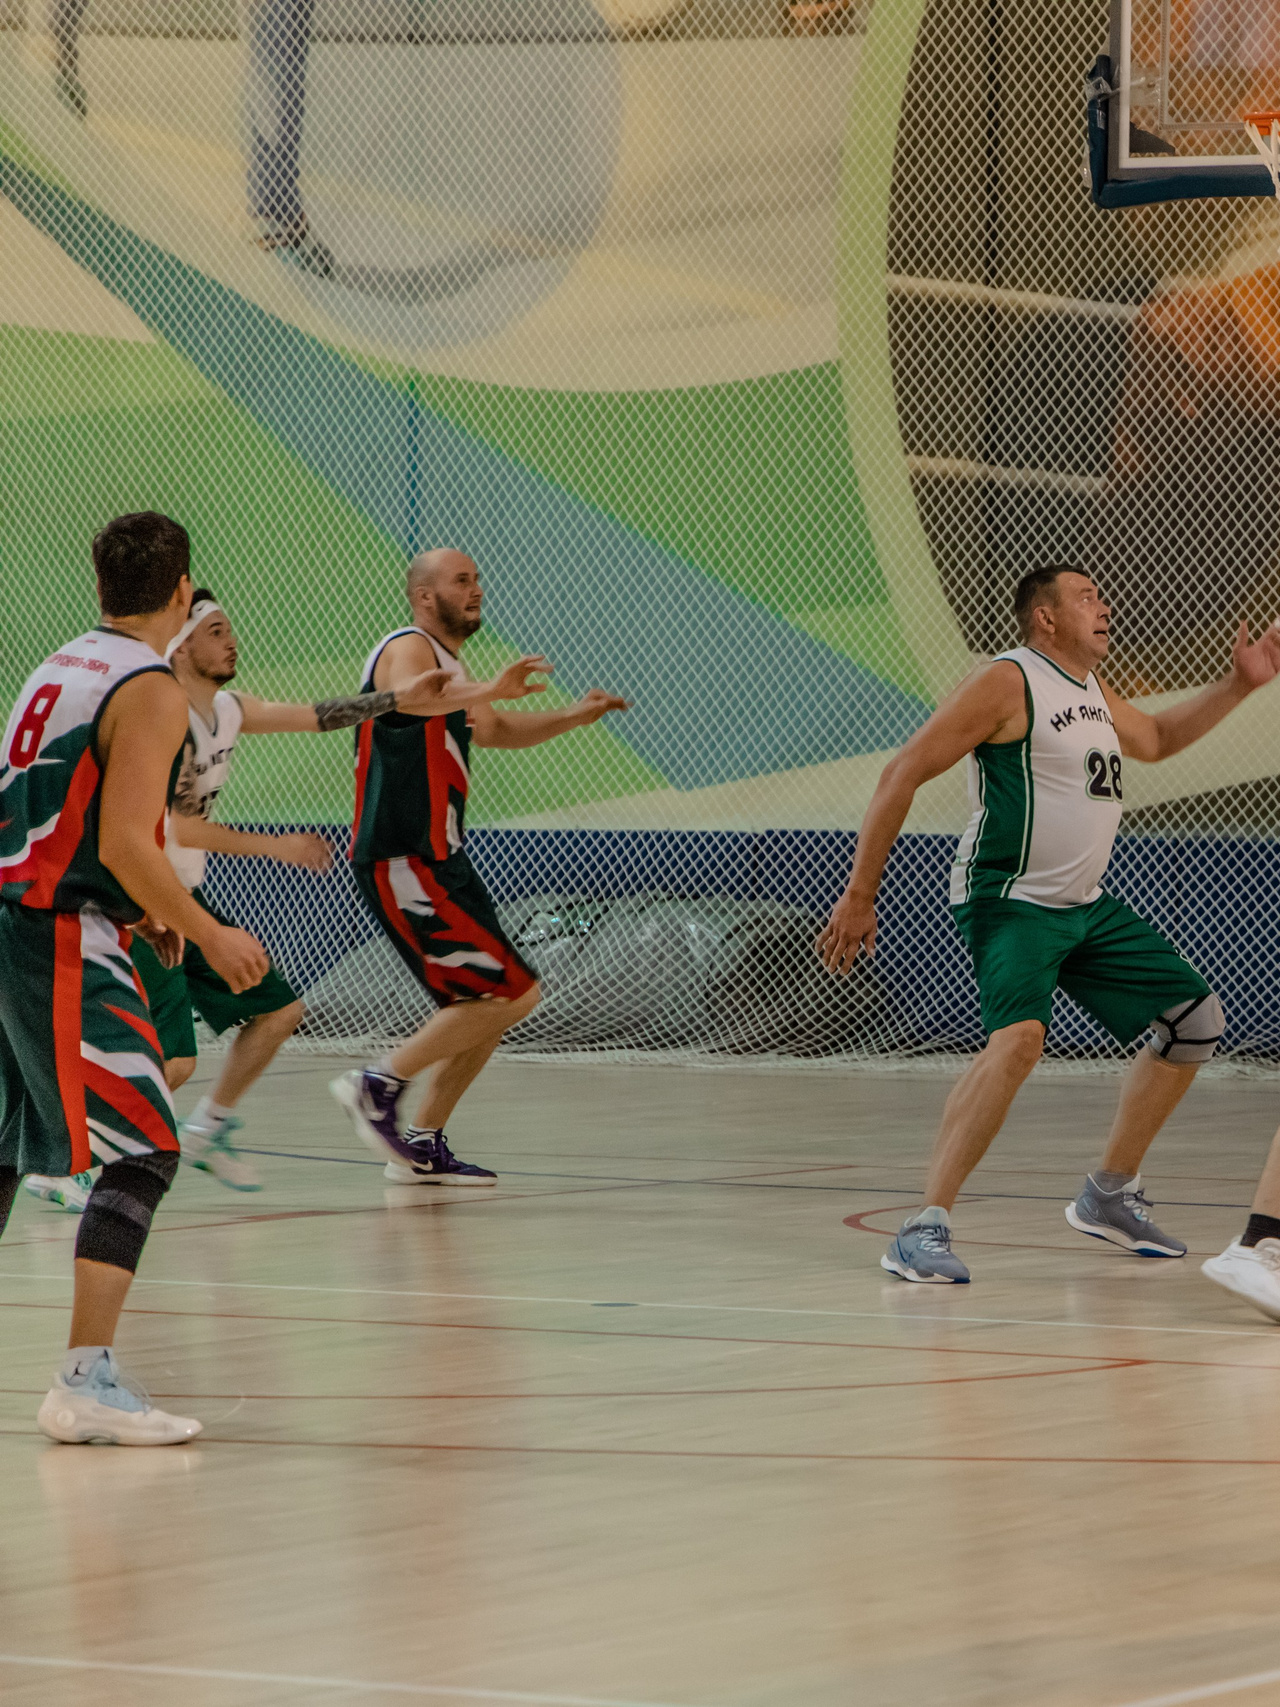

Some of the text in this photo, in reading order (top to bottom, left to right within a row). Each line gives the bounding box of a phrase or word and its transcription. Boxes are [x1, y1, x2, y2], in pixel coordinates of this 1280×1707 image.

[9, 682, 63, 770] 8
[1050, 705, 1078, 733] НК
[1084, 747, 1123, 803] 28
